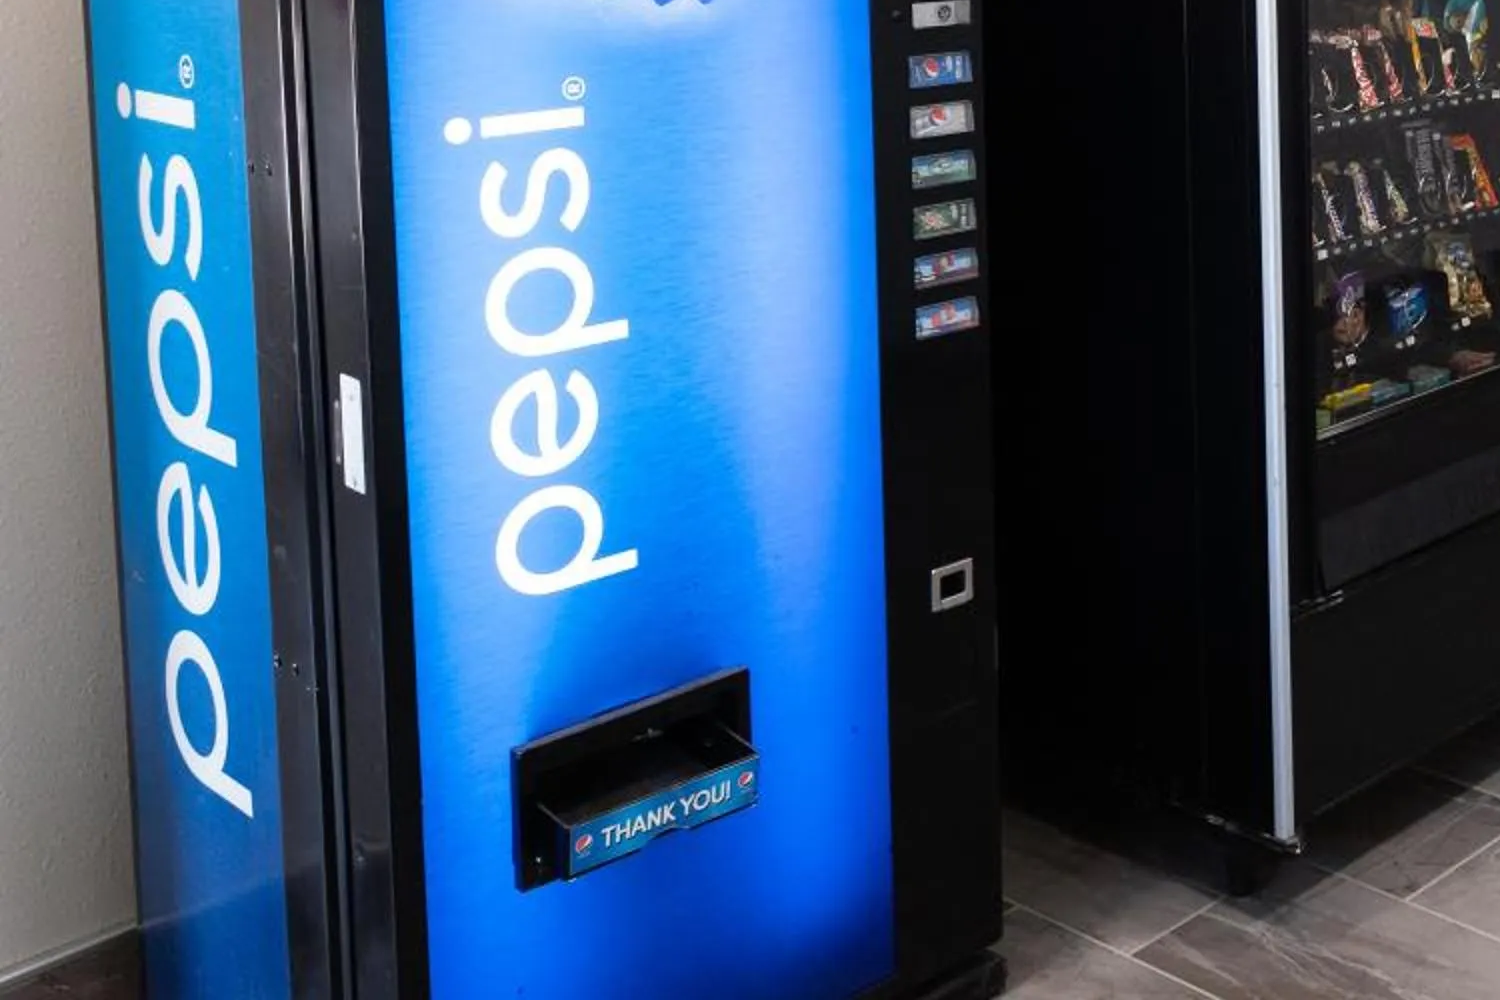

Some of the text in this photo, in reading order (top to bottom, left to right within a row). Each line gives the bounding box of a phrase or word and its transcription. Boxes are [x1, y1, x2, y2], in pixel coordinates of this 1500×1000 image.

[117, 82, 253, 818] pepsi
[444, 106, 638, 596] pepsi
[601, 779, 731, 848] THANK YOU!
